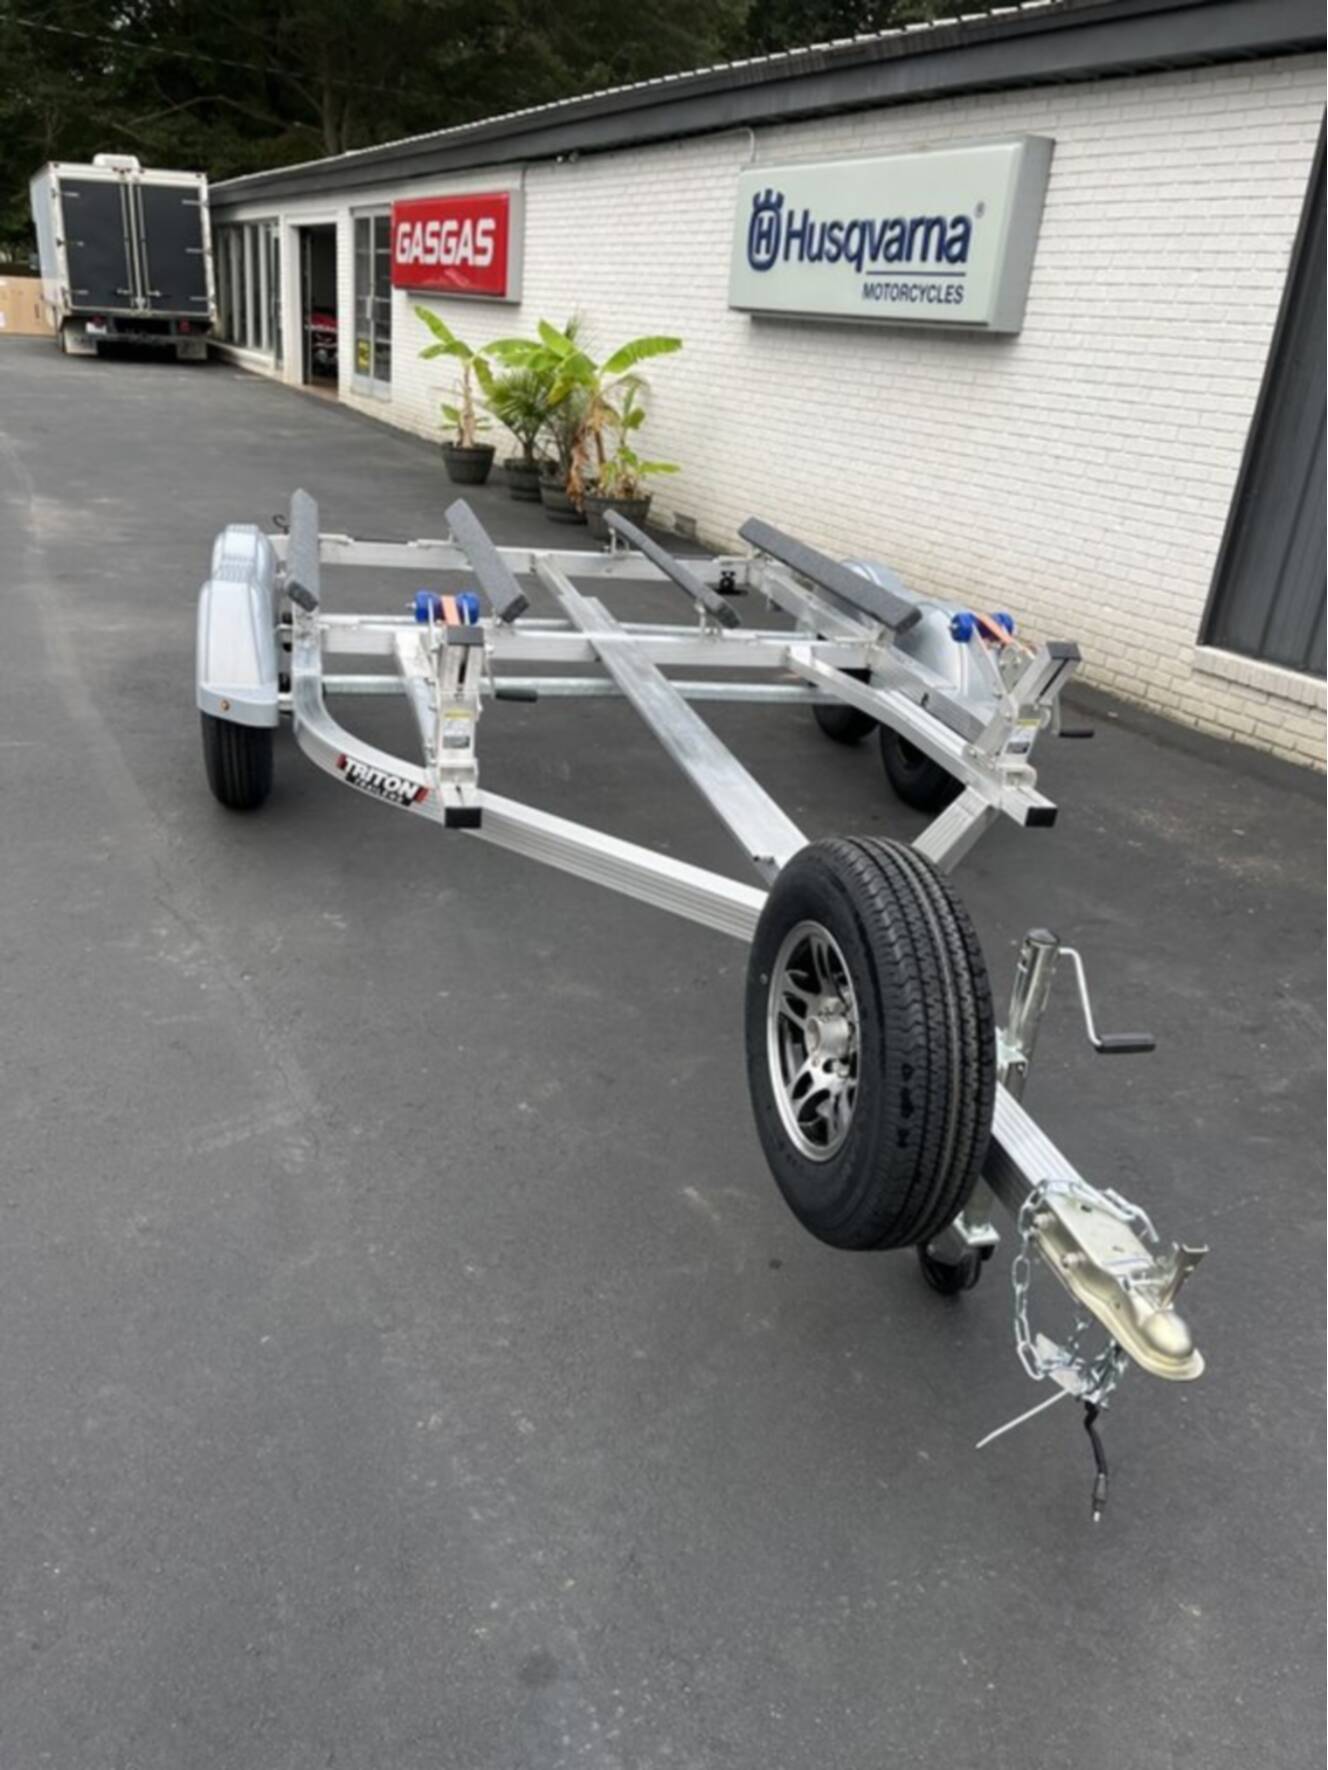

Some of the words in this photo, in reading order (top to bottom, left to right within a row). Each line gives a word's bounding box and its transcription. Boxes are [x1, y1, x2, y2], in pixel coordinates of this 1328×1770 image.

[396, 218, 496, 267] GASGAS
[783, 209, 973, 273] Husqvarna
[862, 282, 964, 305] MOTORCYCLES
[346, 757, 418, 799] TRITON
